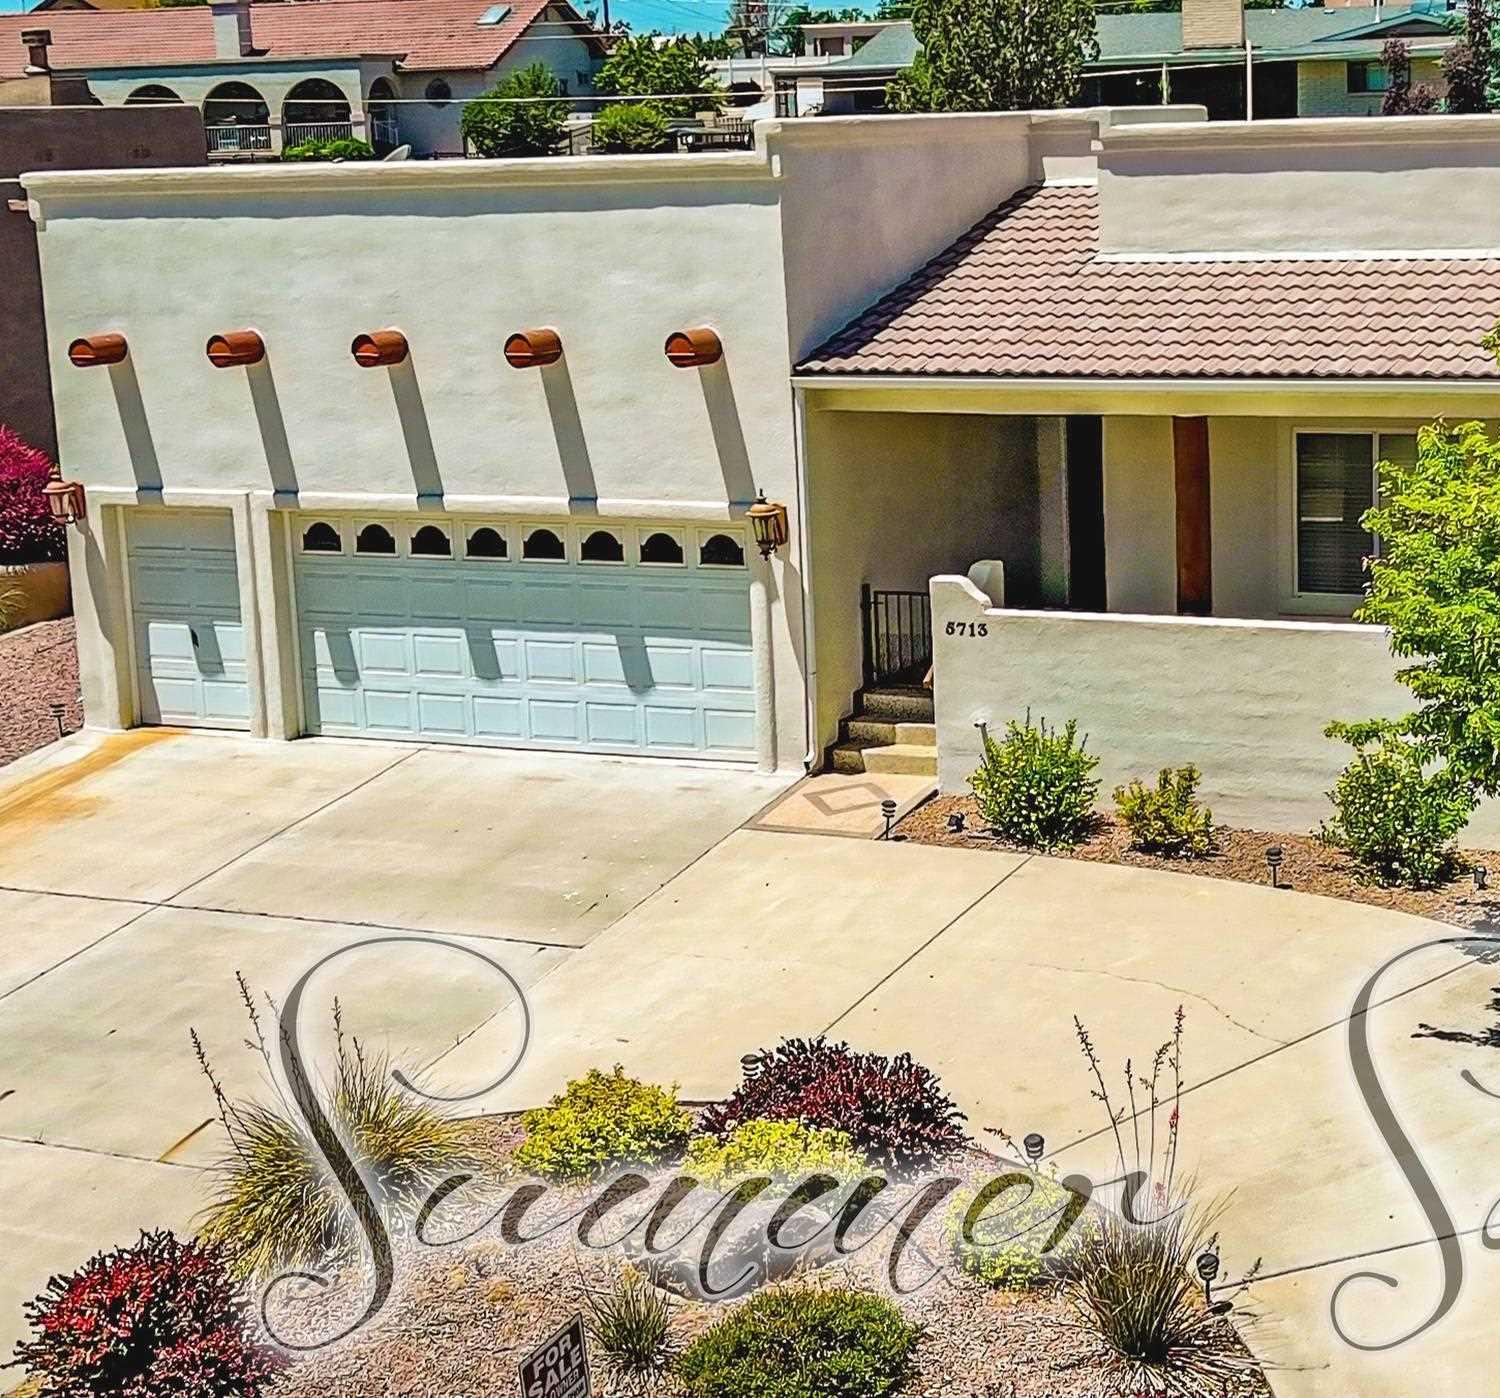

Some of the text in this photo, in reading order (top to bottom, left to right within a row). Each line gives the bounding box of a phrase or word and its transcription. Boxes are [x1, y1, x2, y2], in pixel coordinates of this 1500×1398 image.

[945, 621, 988, 637] 5713
[528, 1344, 582, 1398] SALE
[532, 1334, 572, 1380] FOR
